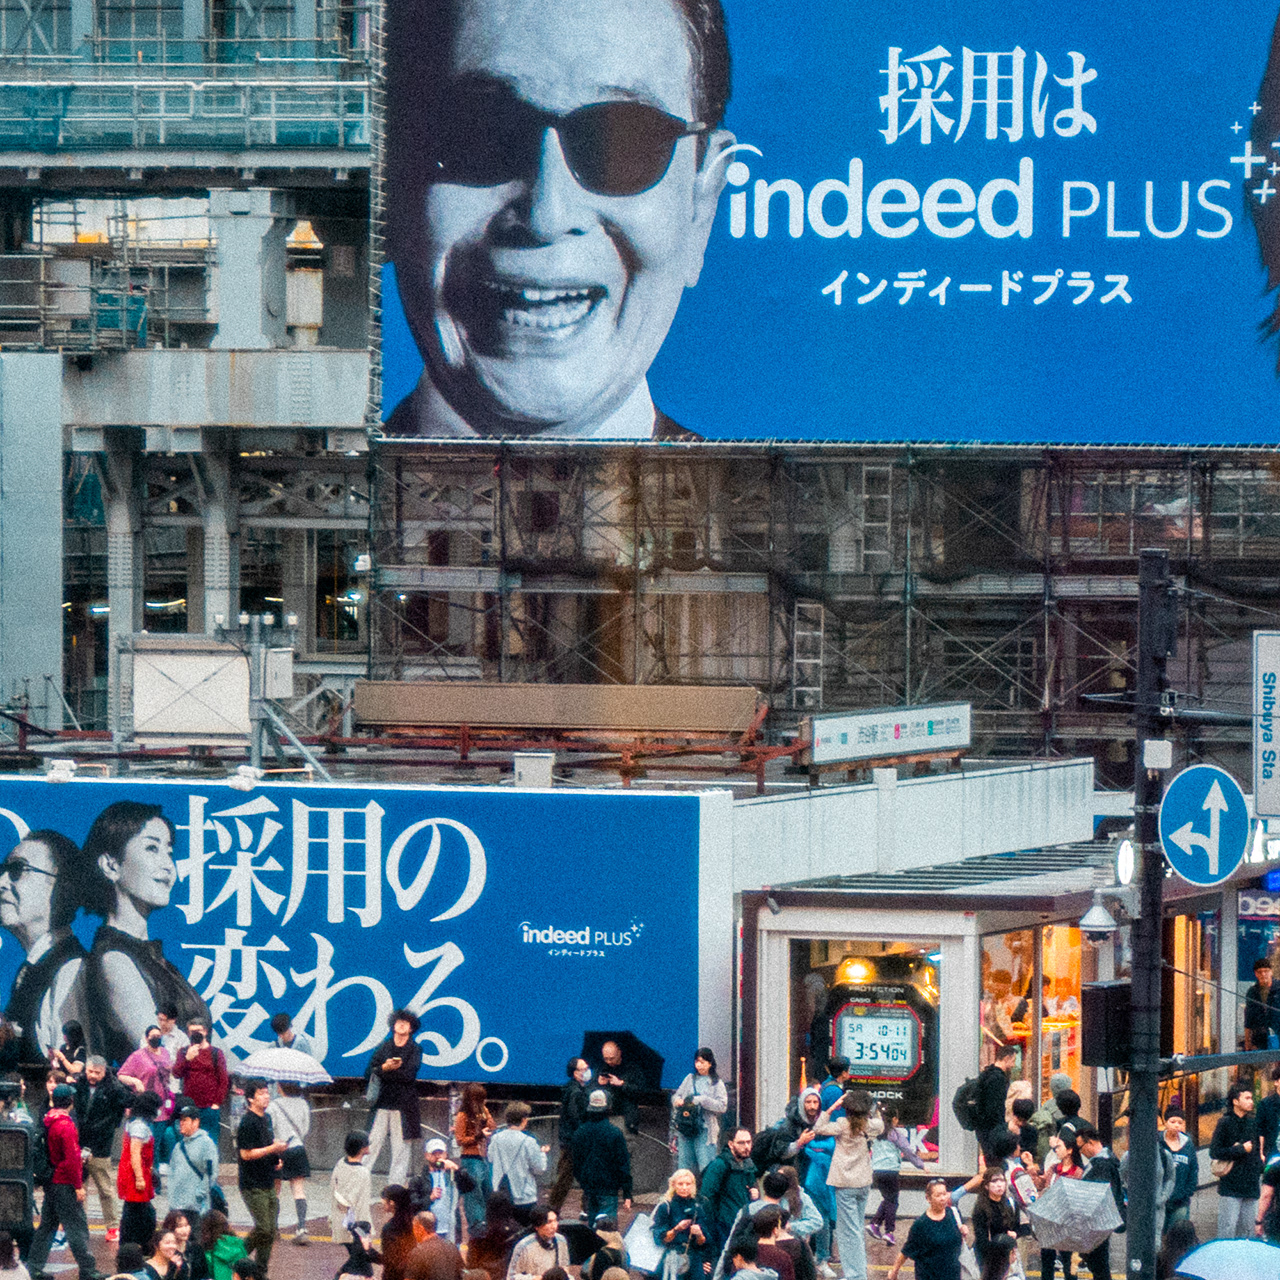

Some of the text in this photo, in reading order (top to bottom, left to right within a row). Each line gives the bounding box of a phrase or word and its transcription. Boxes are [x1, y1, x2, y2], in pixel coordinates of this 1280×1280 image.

[878, 45, 1099, 145] 採用は
[725, 156, 1234, 240] indeed PLUS
[820, 268, 1134, 306] インディードプラス
[1260, 672, 1277, 786] Shibuya Sta.
[175, 794, 488, 928] 採用の
[522, 925, 633, 946] indeed PLUS
